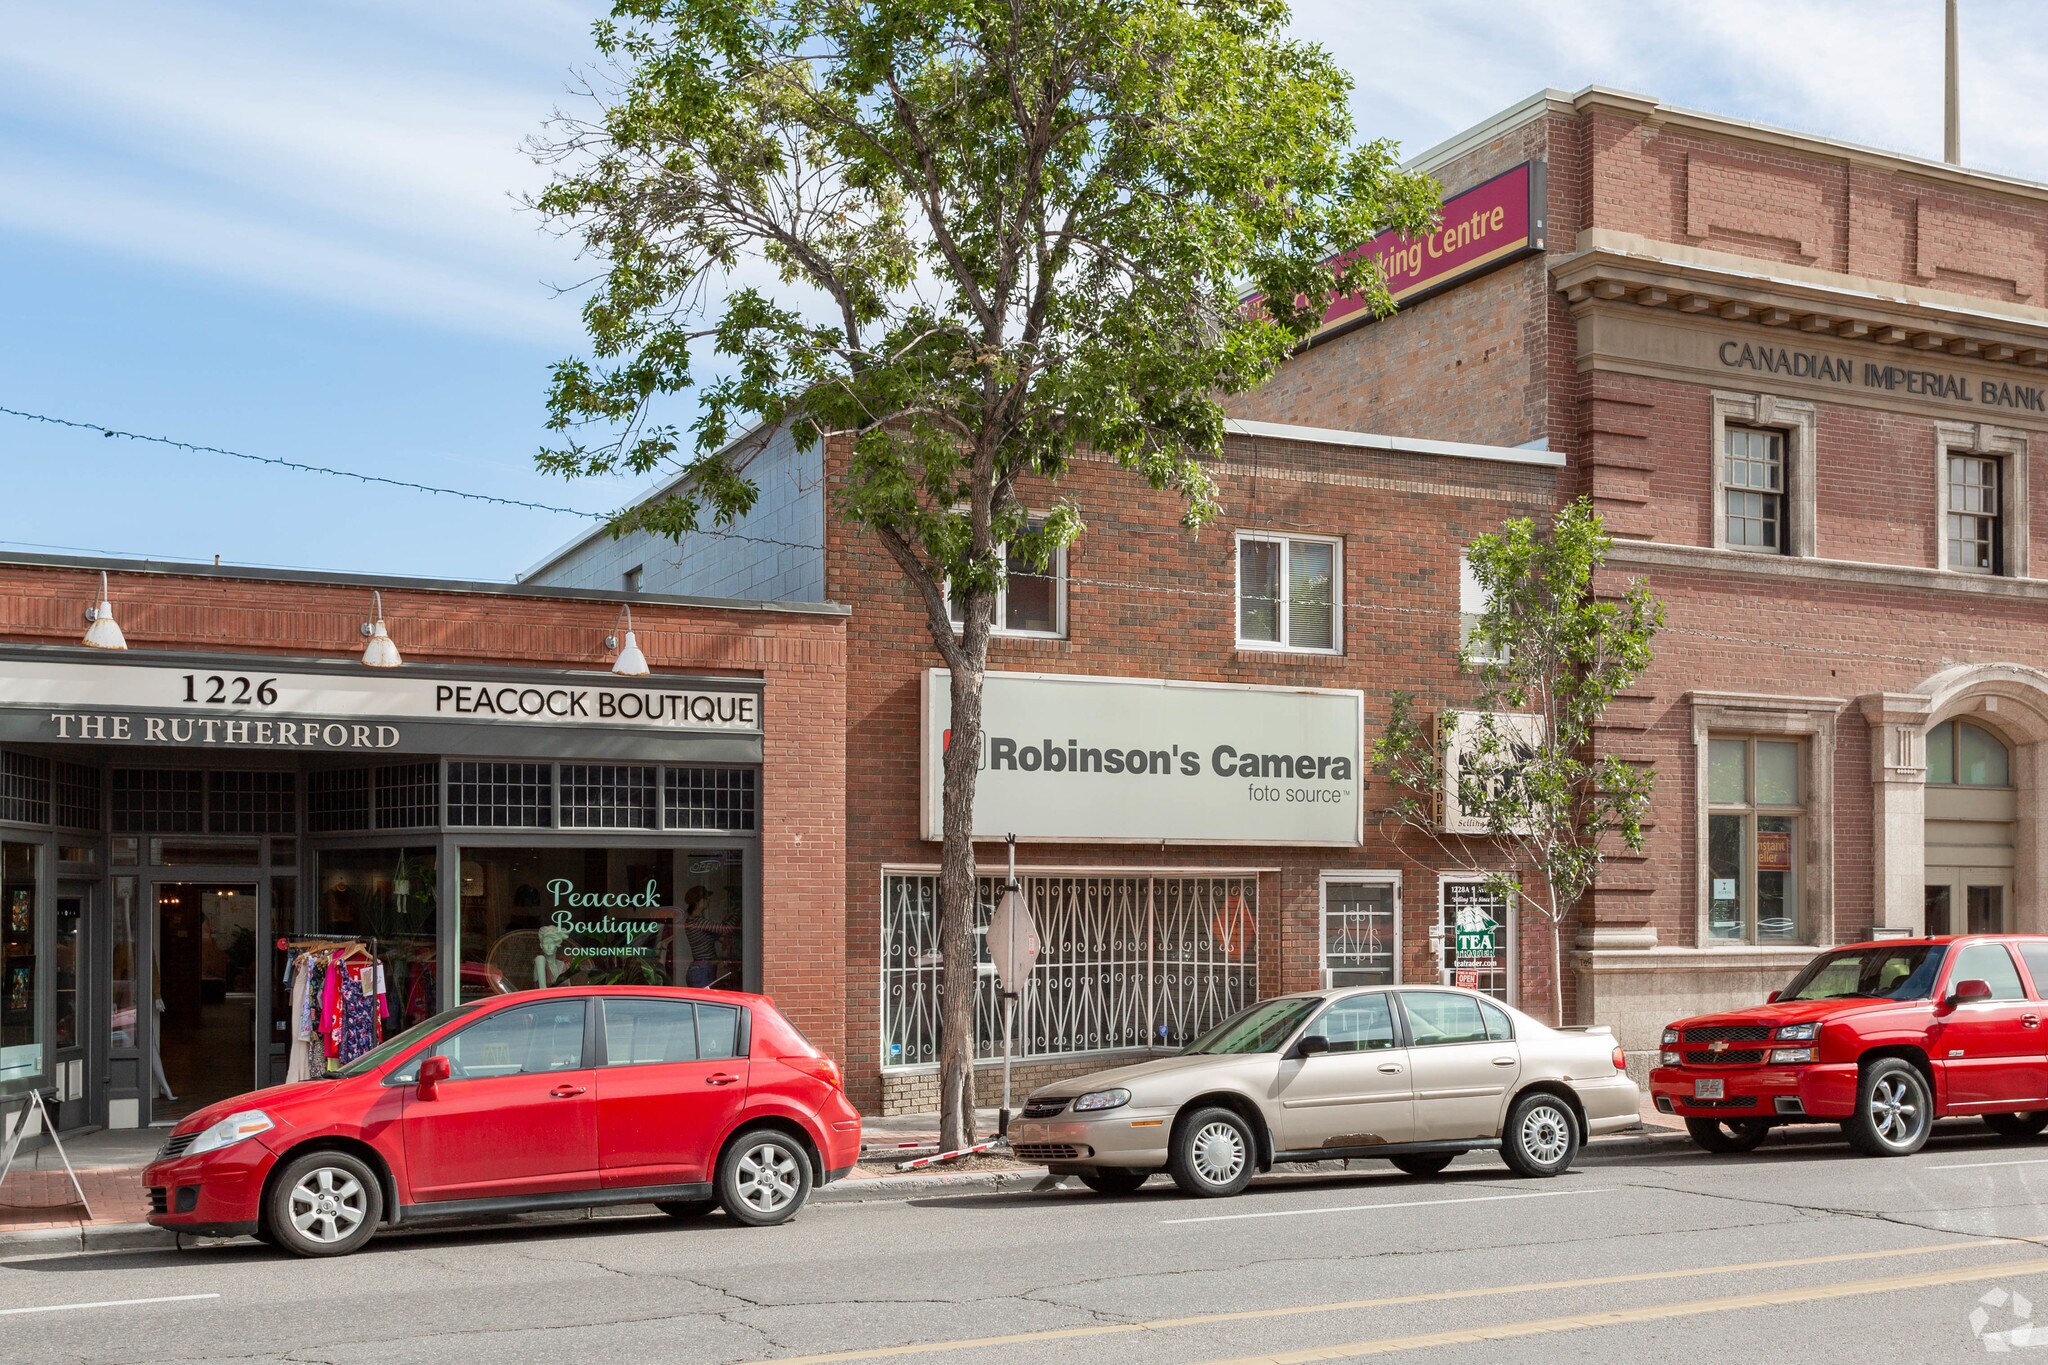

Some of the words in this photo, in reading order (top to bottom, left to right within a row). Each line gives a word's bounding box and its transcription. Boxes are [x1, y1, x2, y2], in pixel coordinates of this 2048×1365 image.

[1428, 205, 1504, 258] Centre
[1719, 341, 1853, 384] CANADIAN
[1864, 363, 1973, 402] IMPERIAL
[1981, 381, 2046, 412] BANK
[182, 674, 278, 706] 1226
[436, 685, 588, 717] PEACOCK
[599, 692, 754, 723] BOUTIQUE
[51, 713, 132, 740] THE
[144, 716, 401, 749] RUTHERFORD
[990, 737, 1201, 777] Robinson's
[1211, 744, 1352, 781] Camera
[1248, 783, 1281, 802] foto
[1758, 842, 1785, 851] nstant
[1758, 851, 1778, 863] eller
[546, 878, 661, 908] Peacock
[551, 910, 660, 945] Boutique
[1459, 935, 1493, 949] TEA
[563, 947, 648, 956] CONSIGNMENT
